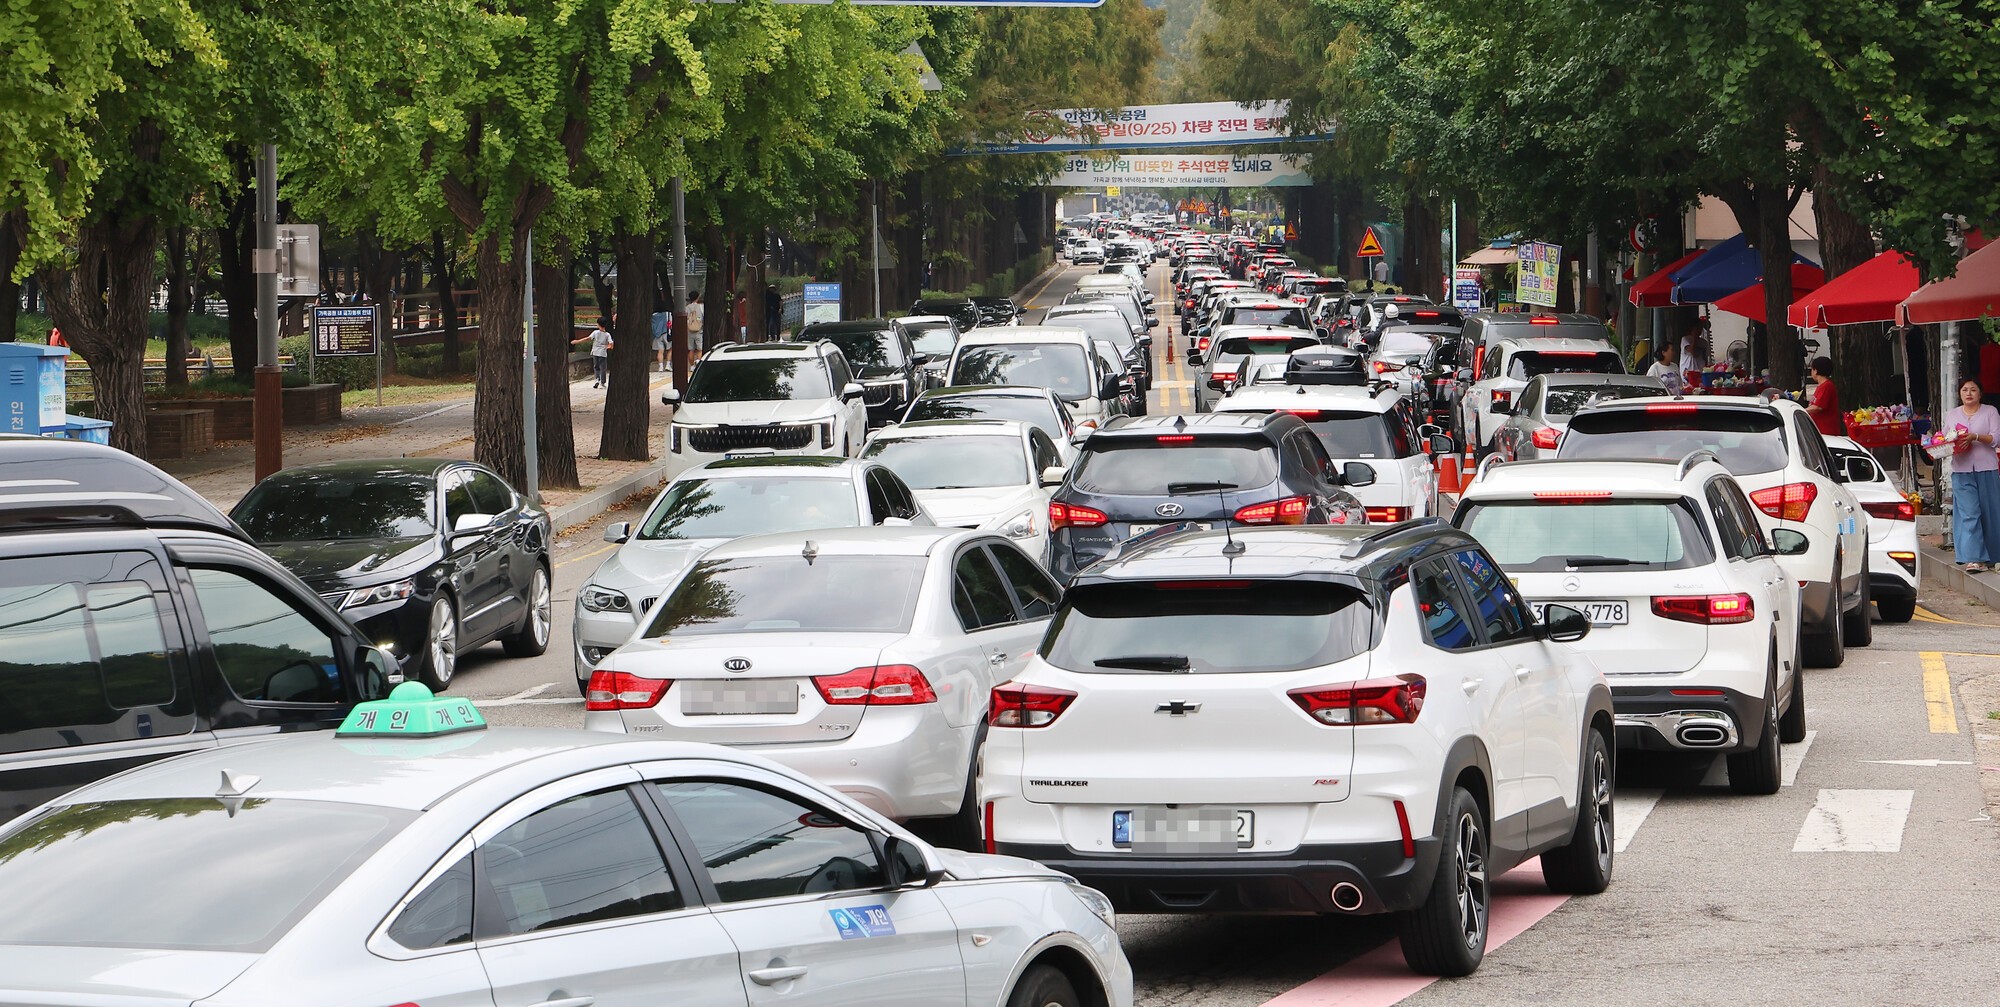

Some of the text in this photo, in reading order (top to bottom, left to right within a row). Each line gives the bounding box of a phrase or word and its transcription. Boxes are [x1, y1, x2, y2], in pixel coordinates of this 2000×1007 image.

[1066, 121, 1177, 137] 추당일(9/25)
[1182, 120, 1213, 133] 차량
[1218, 118, 1248, 132] 전면
[1062, 159, 1273, 173] 성한 한가위 따뜻한 추석연휴 되세요
[1521, 260, 1535, 273] 축대
[1521, 274, 1541, 289] 납골당
[11, 401, 24, 431] 인천
[728, 661, 747, 669] KIA
[1029, 779, 1089, 787] TRAILBLAZER
[1313, 778, 1340, 786] RS
[865, 908, 889, 926] 개인
